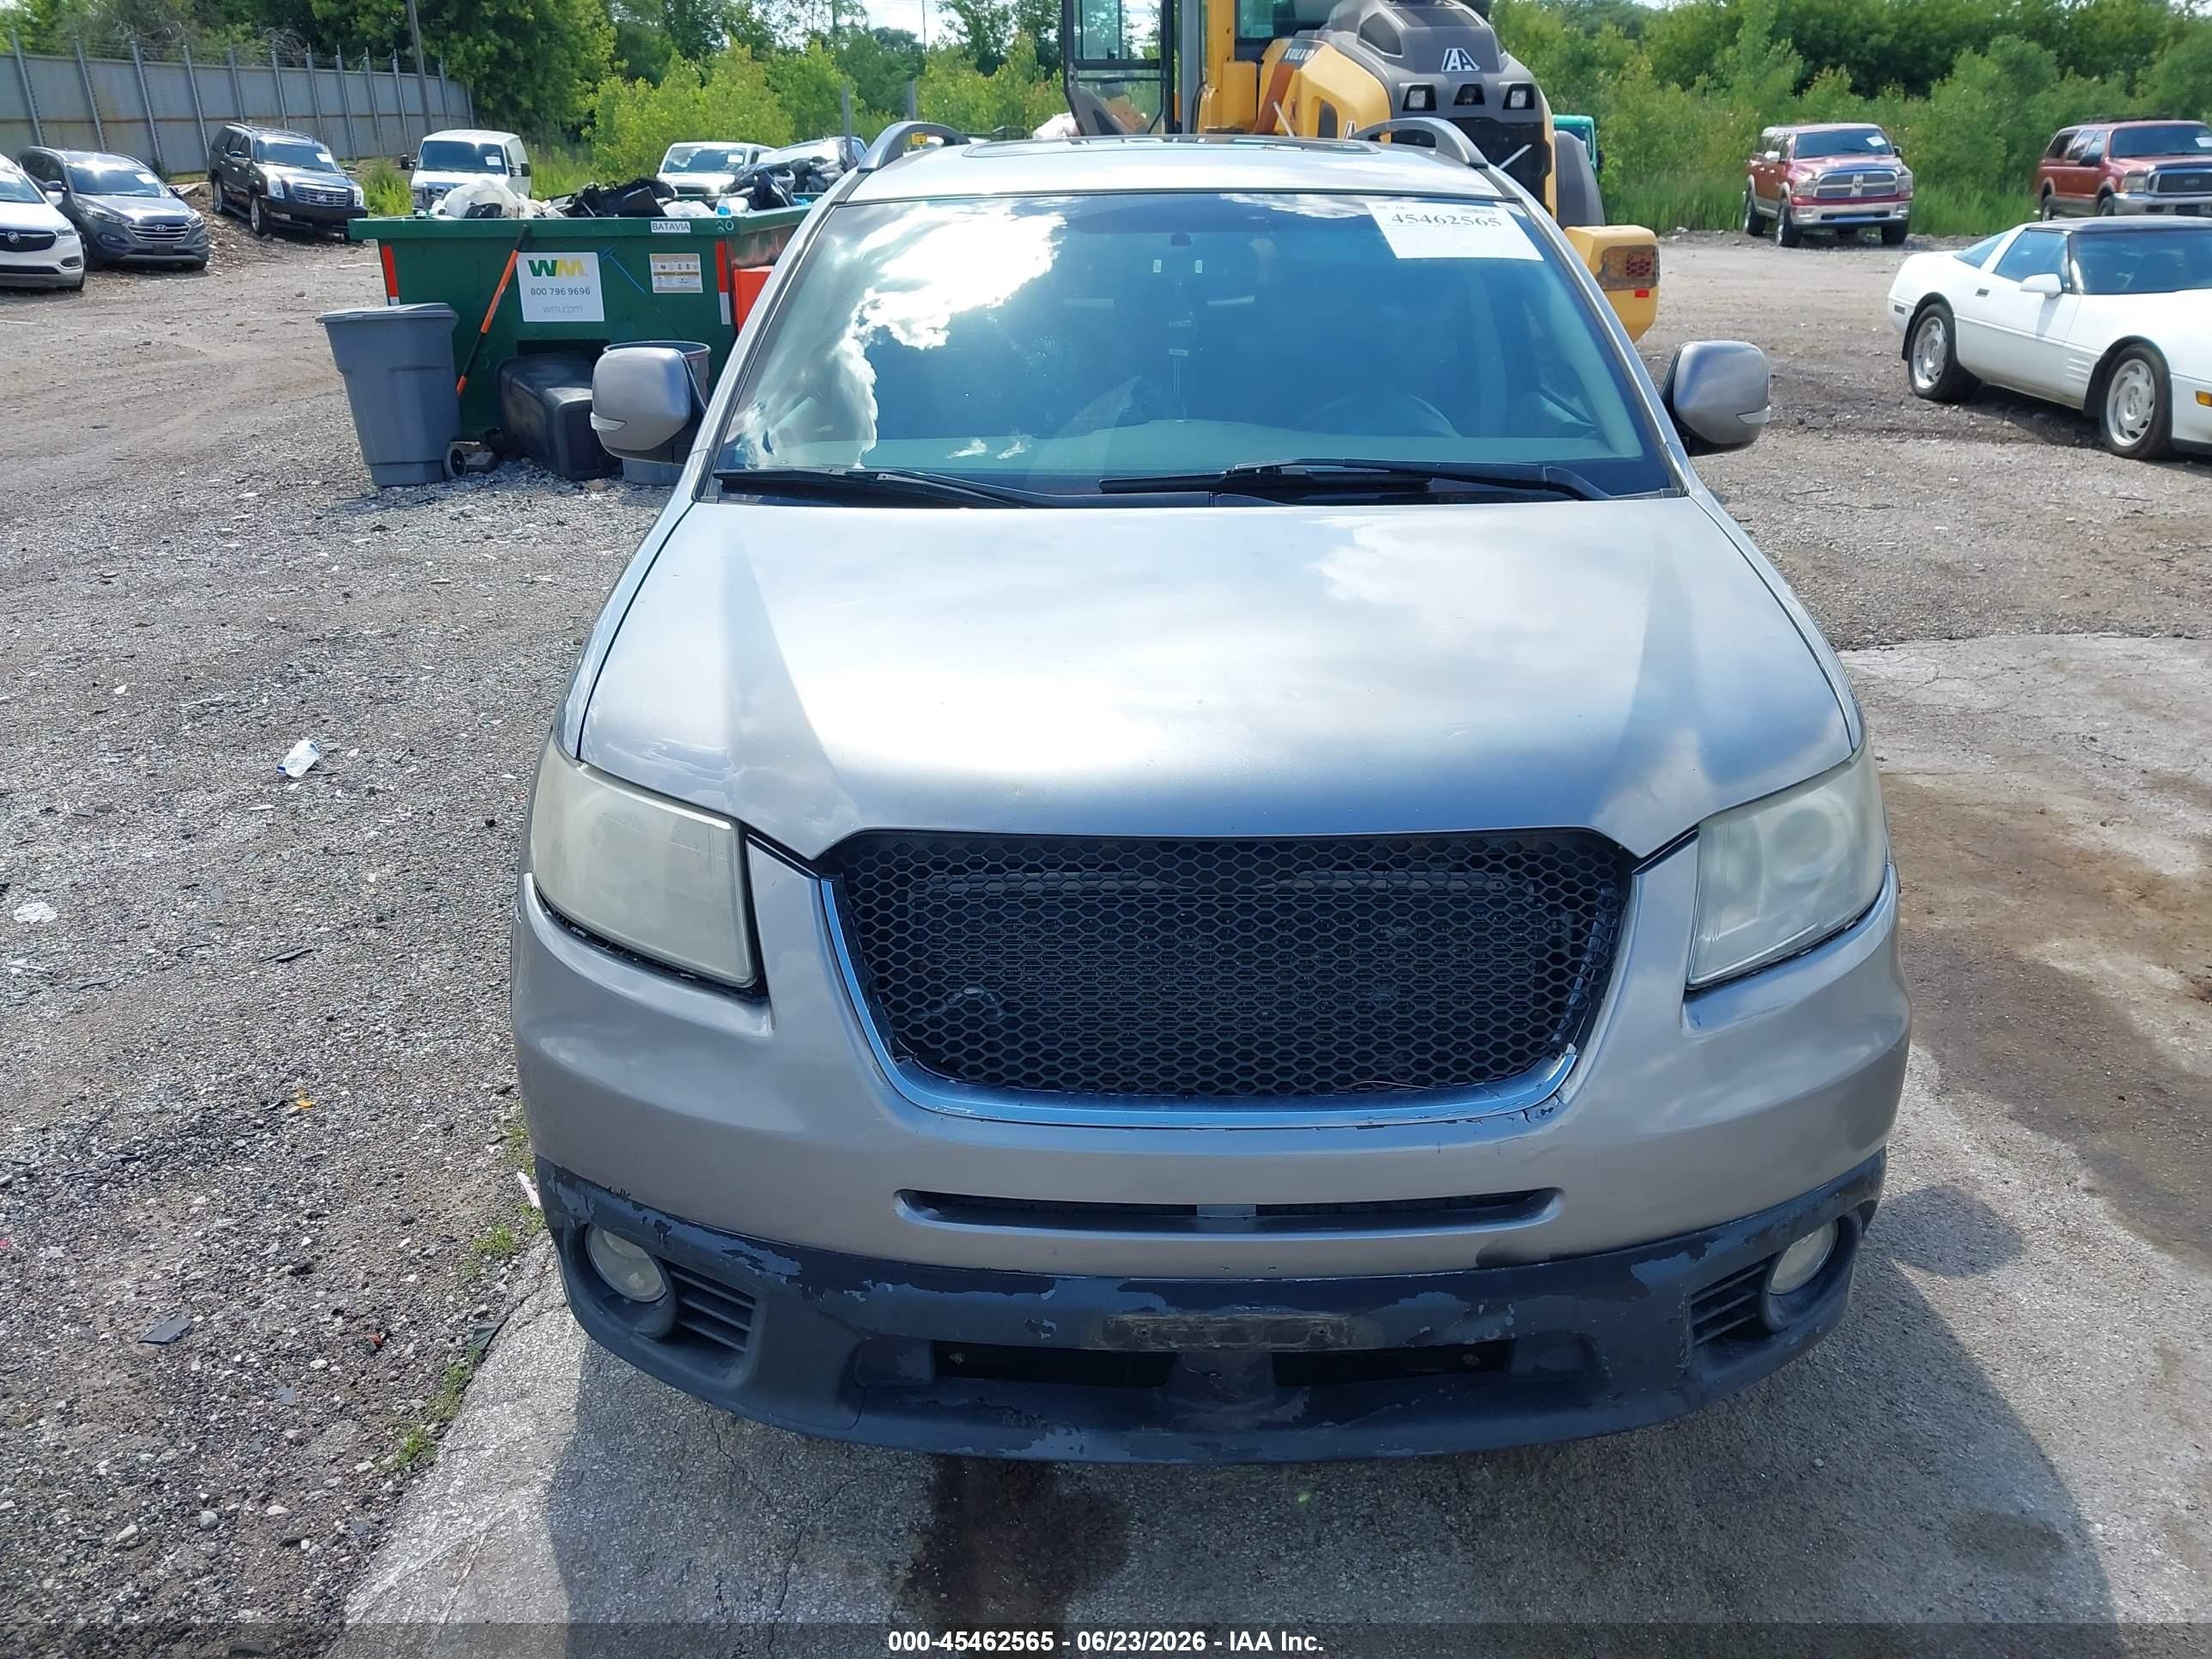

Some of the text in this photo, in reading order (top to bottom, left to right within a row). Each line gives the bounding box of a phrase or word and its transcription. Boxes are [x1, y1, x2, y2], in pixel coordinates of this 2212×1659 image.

[1390, 213, 1503, 228] 45462565
[652, 222, 690, 232] BATAVIA
[527, 259, 586, 277] WM
[531, 288, 591, 296] 800 796 9696
[543, 305, 583, 314] wm.com
